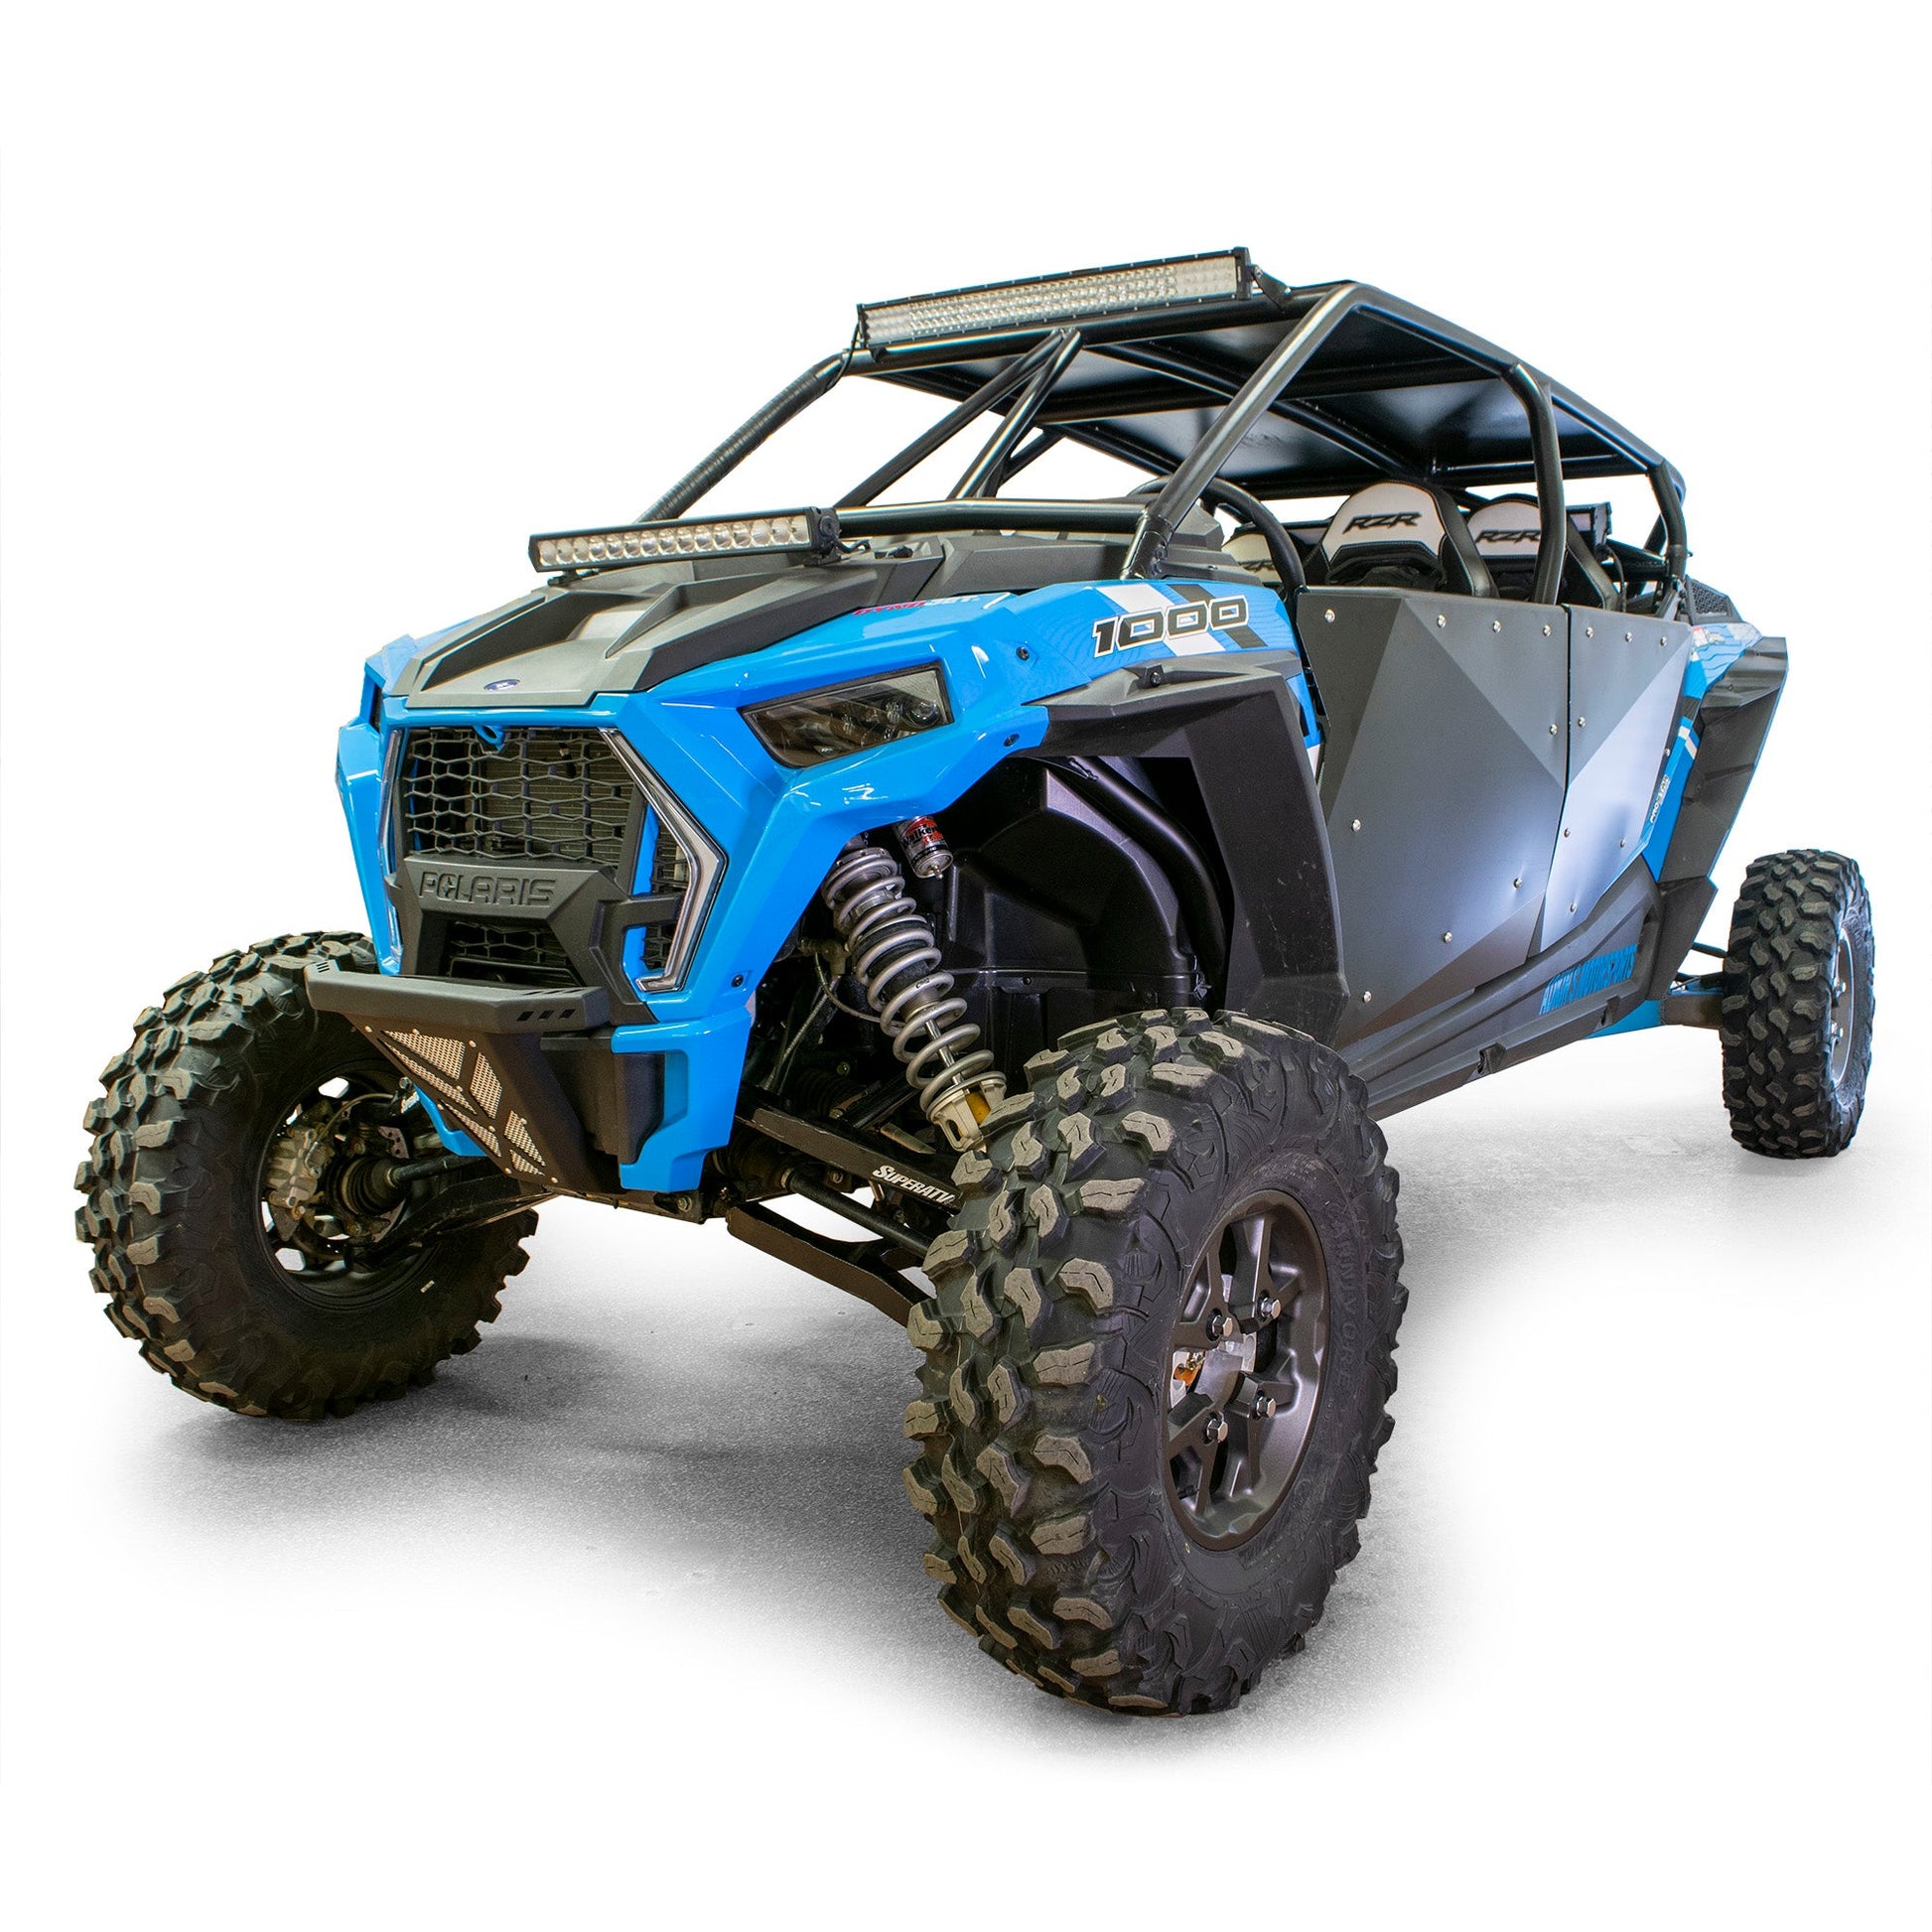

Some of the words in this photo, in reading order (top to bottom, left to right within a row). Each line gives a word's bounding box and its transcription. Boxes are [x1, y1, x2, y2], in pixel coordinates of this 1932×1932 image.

[1342, 512, 1422, 534] RZR
[1475, 529, 1541, 544] RZR
[1092, 596, 1249, 658] 1000
[419, 871, 556, 907] POLARIS
